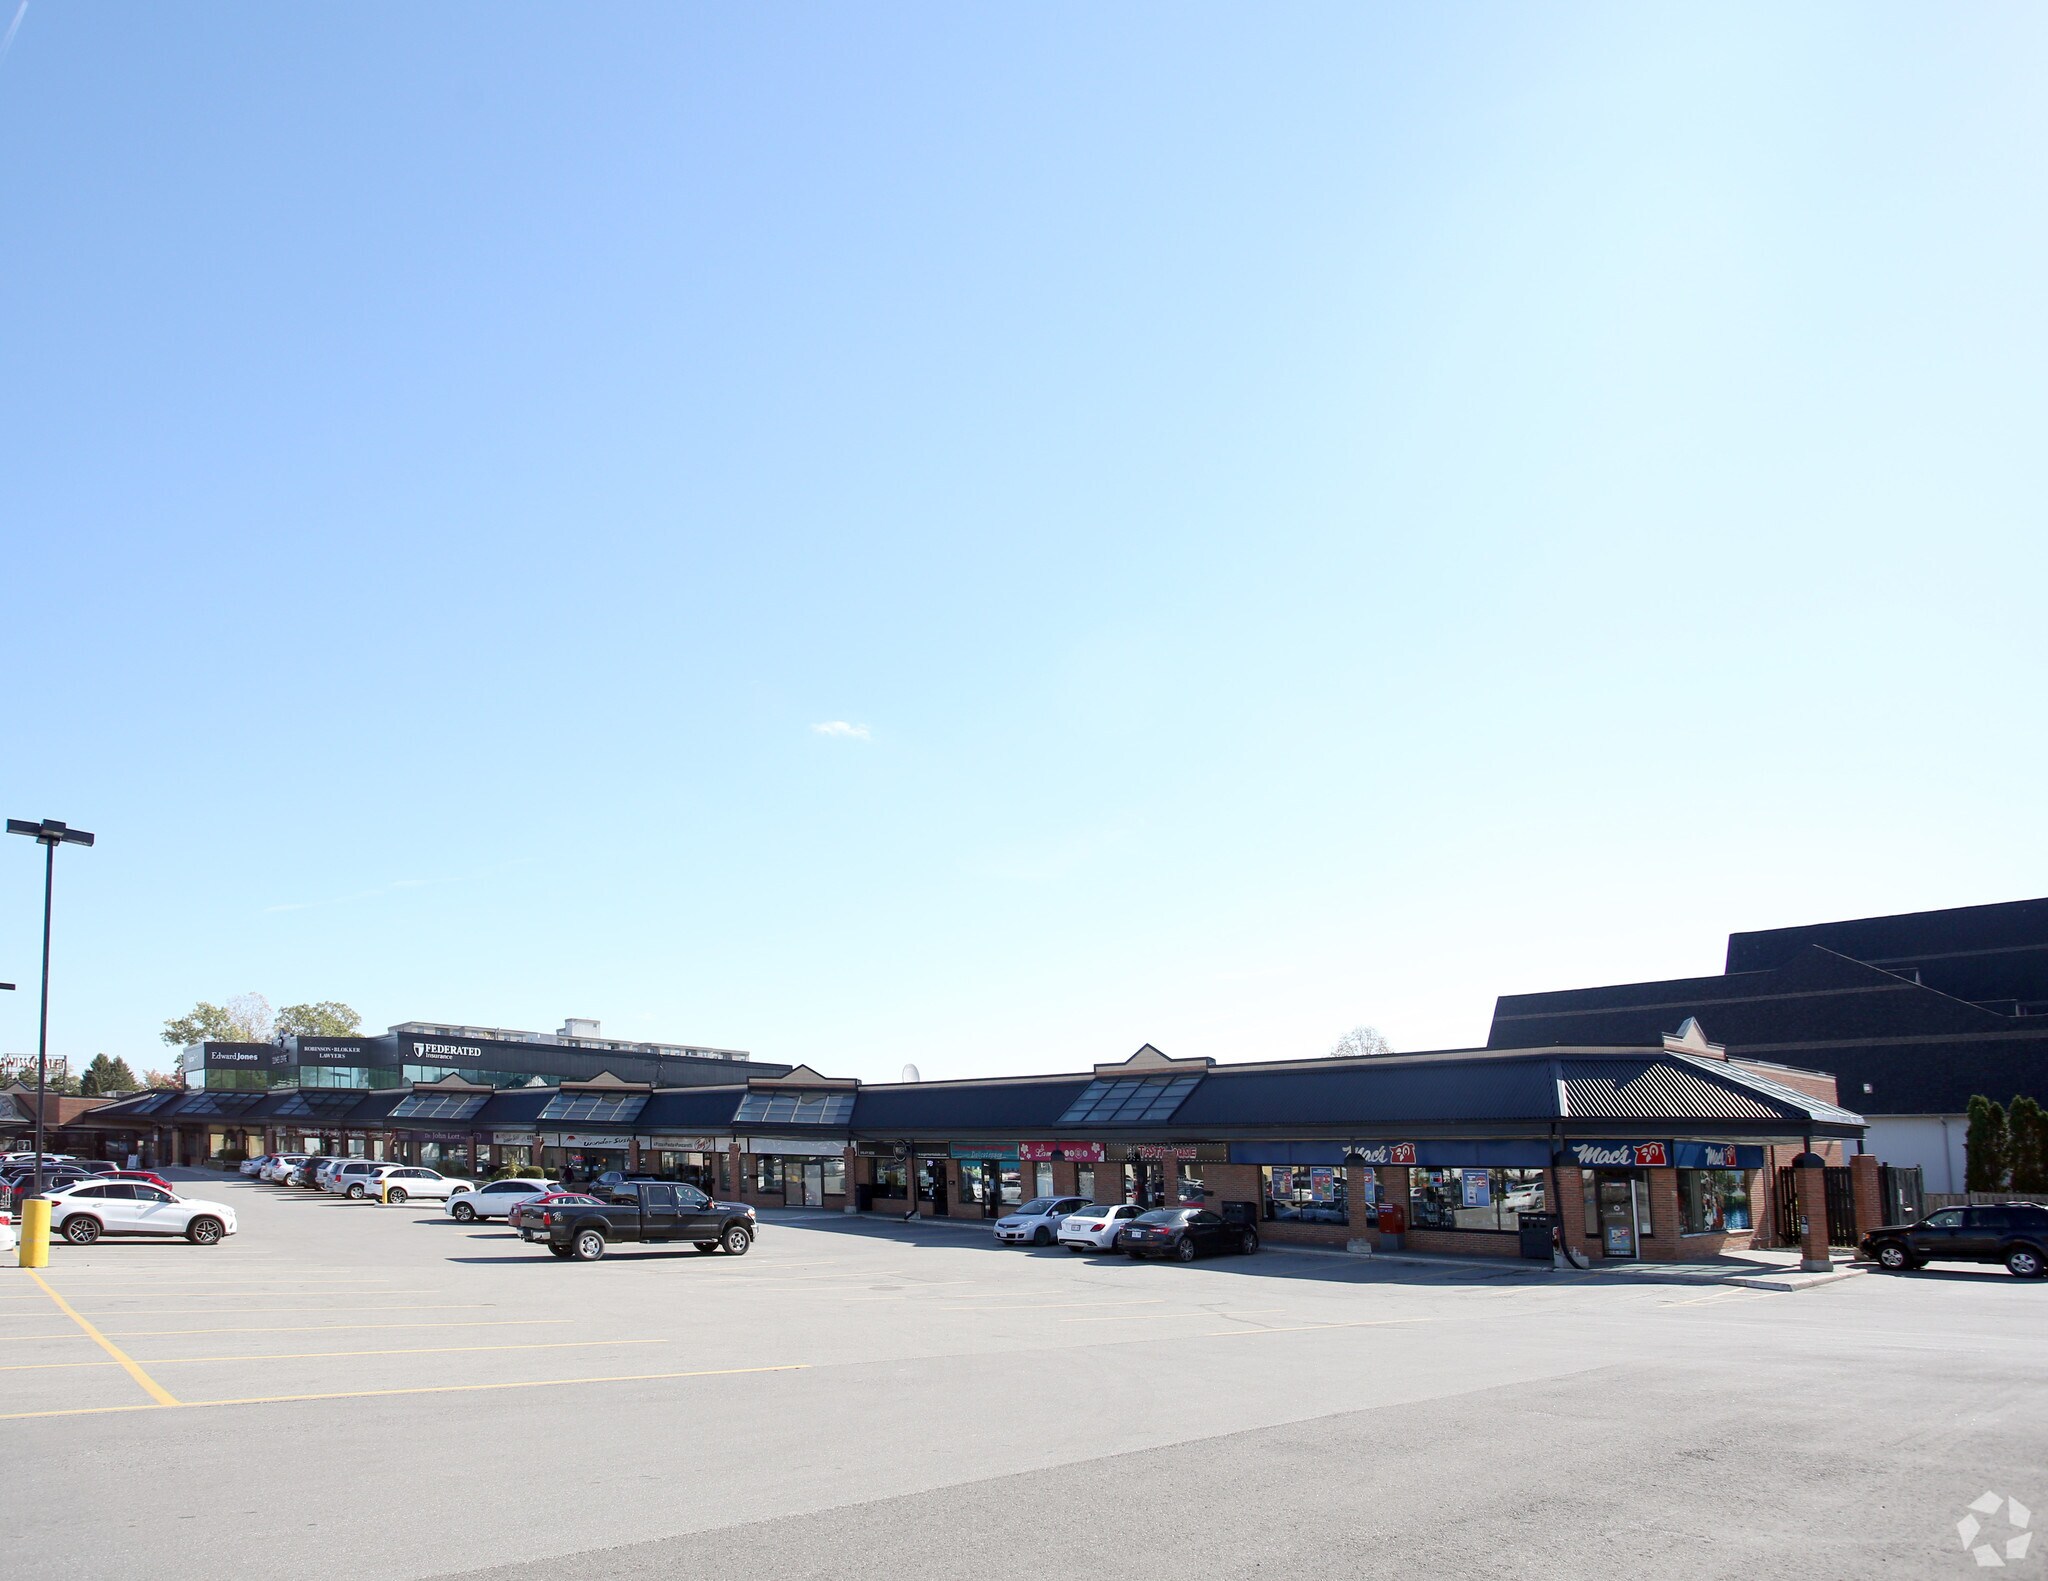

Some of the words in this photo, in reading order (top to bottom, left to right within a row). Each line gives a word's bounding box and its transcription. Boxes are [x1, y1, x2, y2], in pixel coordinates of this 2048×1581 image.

[425, 1043, 482, 1057] FEDERATED
[425, 1052, 453, 1060] Insurance
[432, 1131, 447, 1139] John
[1572, 1144, 1631, 1165] Mac's
[1705, 1146, 1725, 1166] Mac's
